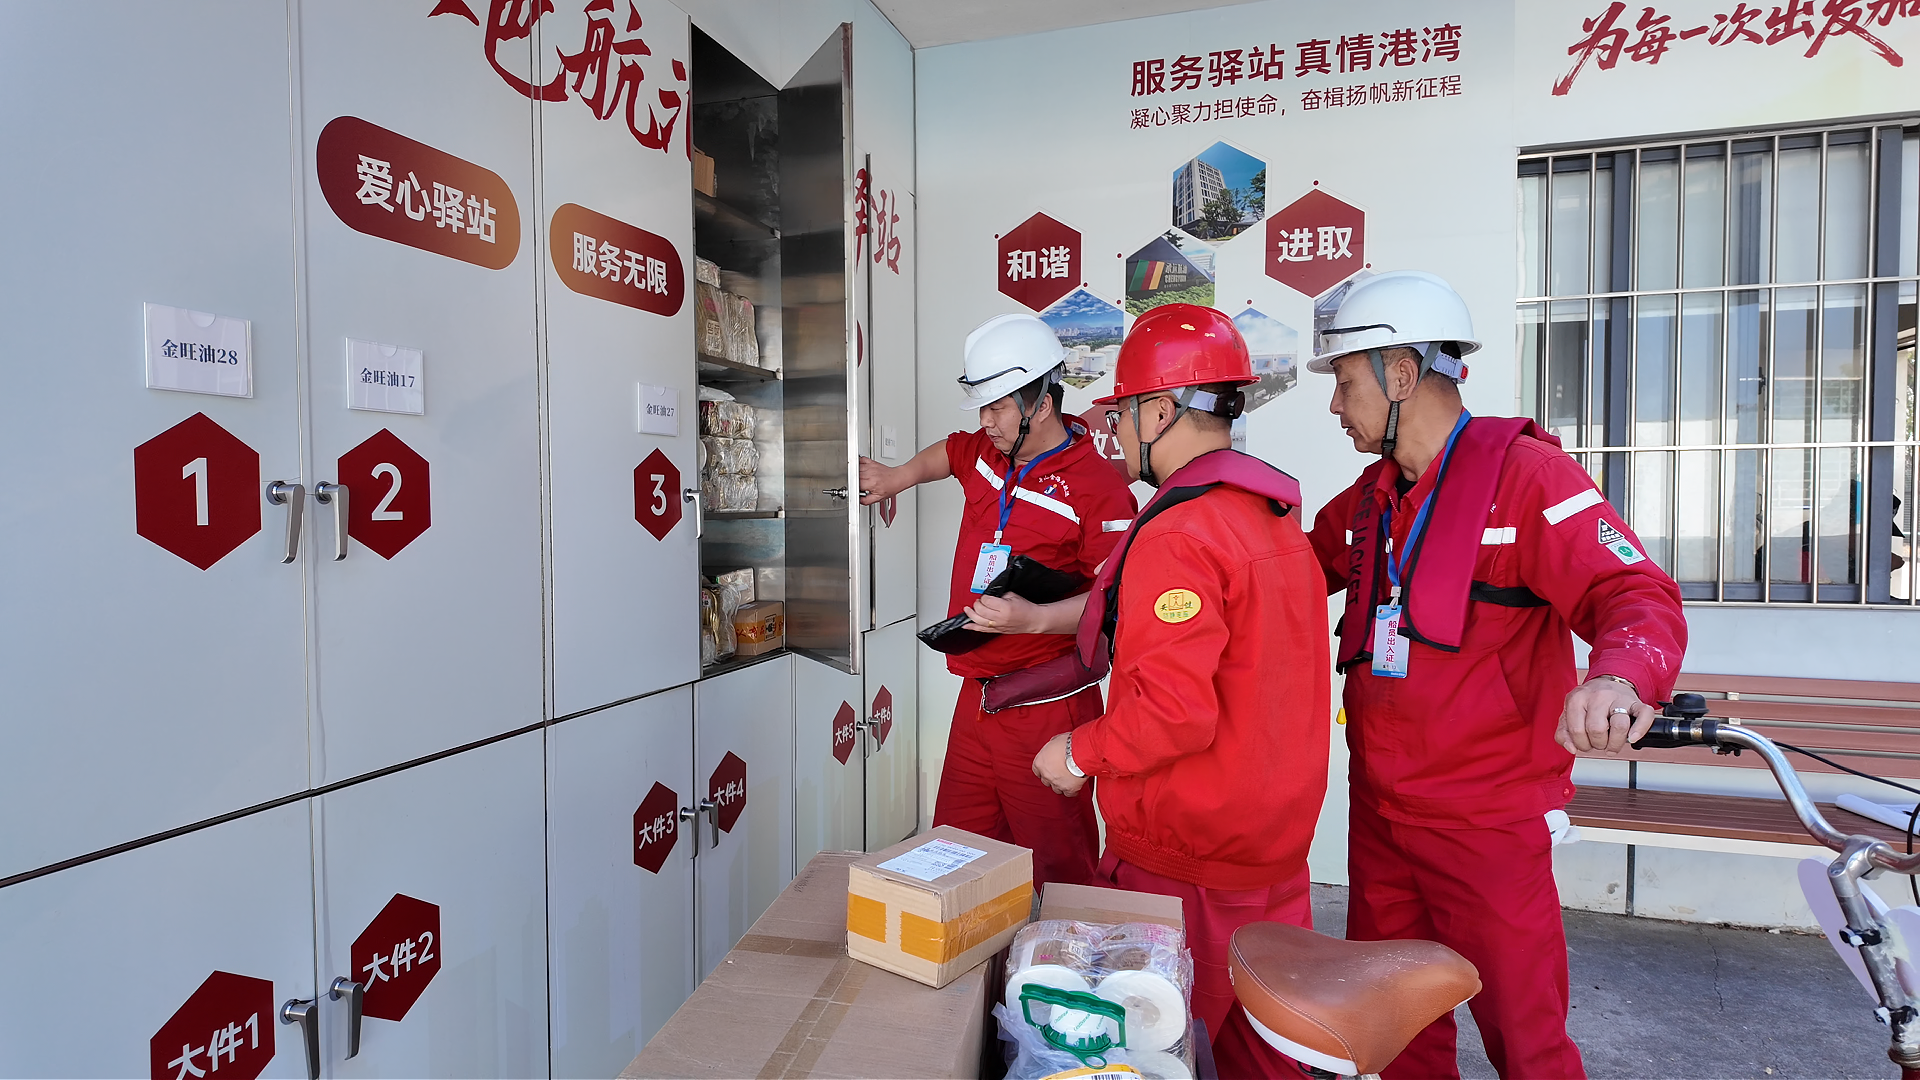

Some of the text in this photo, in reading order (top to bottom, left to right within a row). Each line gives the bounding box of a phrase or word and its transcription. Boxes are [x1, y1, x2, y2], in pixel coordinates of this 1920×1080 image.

[1131, 23, 1462, 97] 服务驿站 真情港湾
[356, 153, 497, 244] 爱心驿站
[572, 231, 669, 297] 服务无限
[1006, 245, 1072, 282] 和谐
[1277, 225, 1354, 264] 进取
[161, 338, 238, 366] 金旺油28
[360, 367, 415, 388] 金旺油17
[646, 403, 674, 417] 金旺油27
[182, 457, 209, 526] 1
[370, 462, 404, 521] 2
[650, 473, 667, 516] 3
[1385, 620, 1398, 663] 船员出入证
[834, 721, 854, 747] 大件5
[713, 777, 745, 807] 大件4
[638, 810, 675, 850] 大件3
[362, 930, 434, 994] 大件2
[167, 1011, 260, 1080] 大件1
